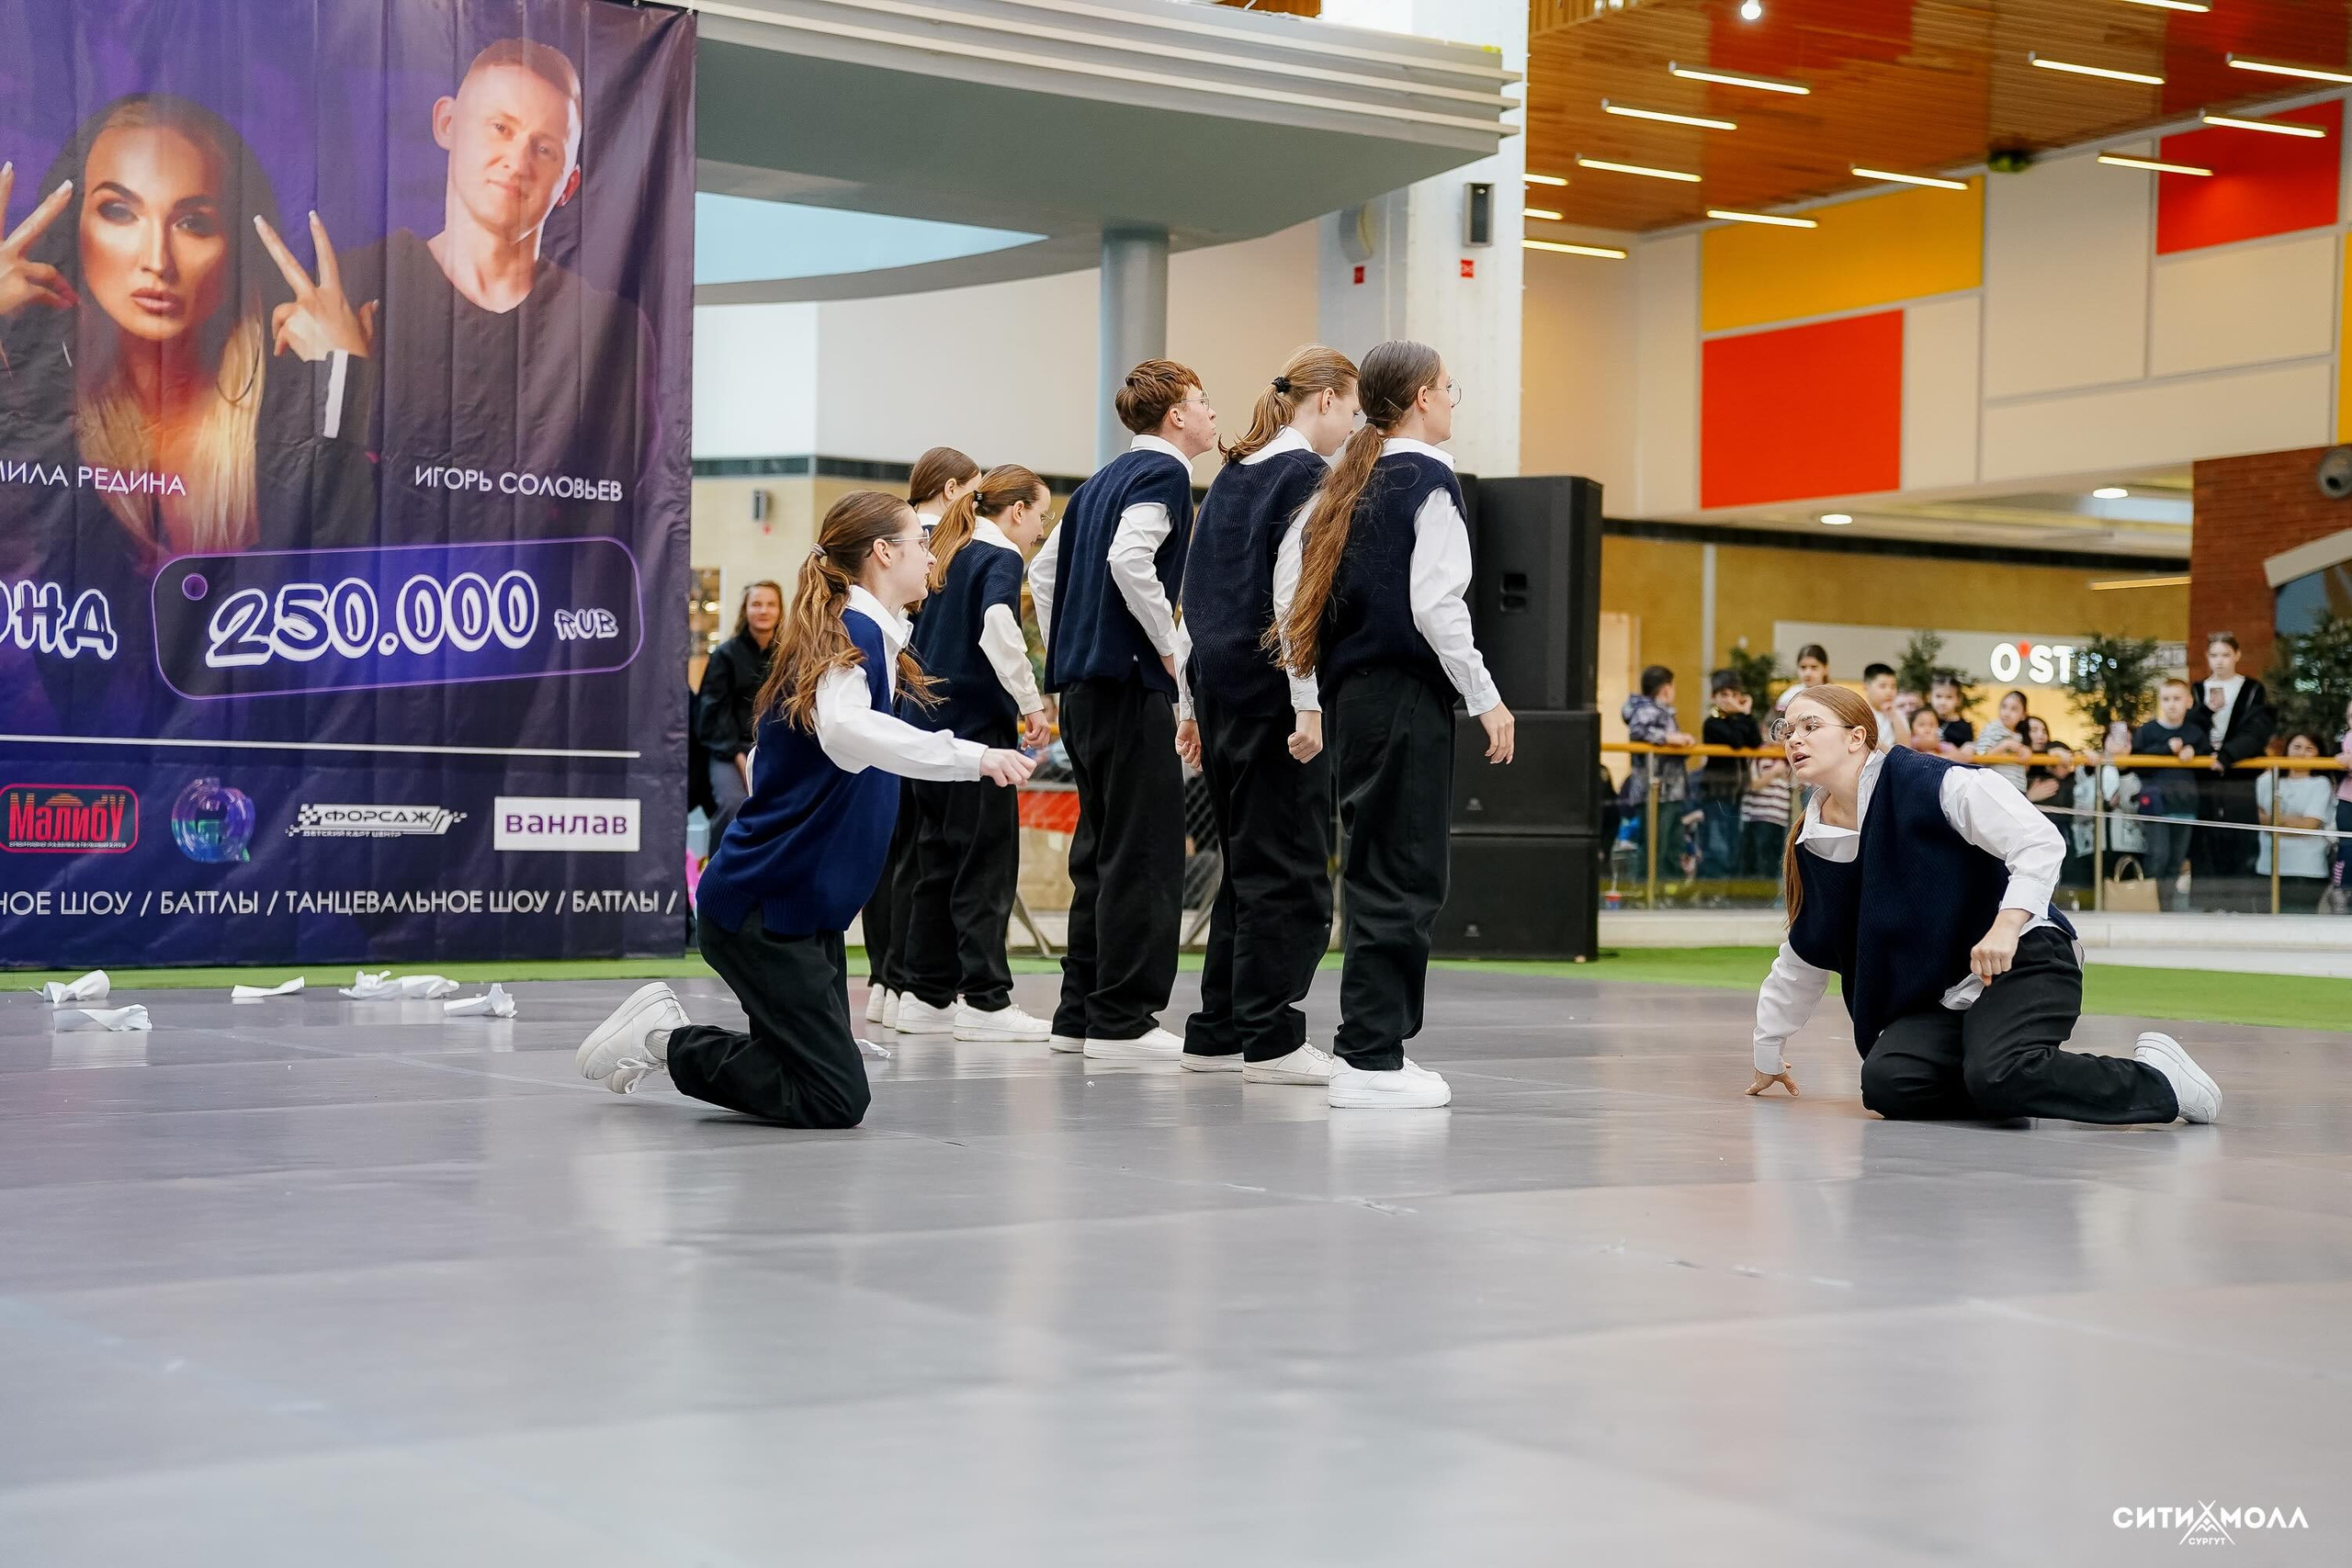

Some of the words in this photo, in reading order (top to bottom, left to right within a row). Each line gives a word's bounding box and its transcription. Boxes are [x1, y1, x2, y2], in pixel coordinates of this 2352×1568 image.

[77, 466, 187, 496] РЕДИНА
[415, 465, 493, 491] ИГОРЬ
[499, 471, 624, 502] СОЛОВЬЕВ
[205, 570, 539, 668] 250.000
[553, 608, 620, 641] RUB
[1990, 641, 2113, 684] O'ST
[324, 810, 433, 824] ФОРСАЖ
[505, 814, 628, 835] ванлав
[61, 890, 132, 916] ШОУ
[160, 890, 258, 915] БАТТЛЫ
[286, 889, 483, 917] ТАНЦЕВАЛЬНОЕ
[489, 889, 550, 914] ШОУ
[572, 889, 659, 914] БАТТЛЫ
